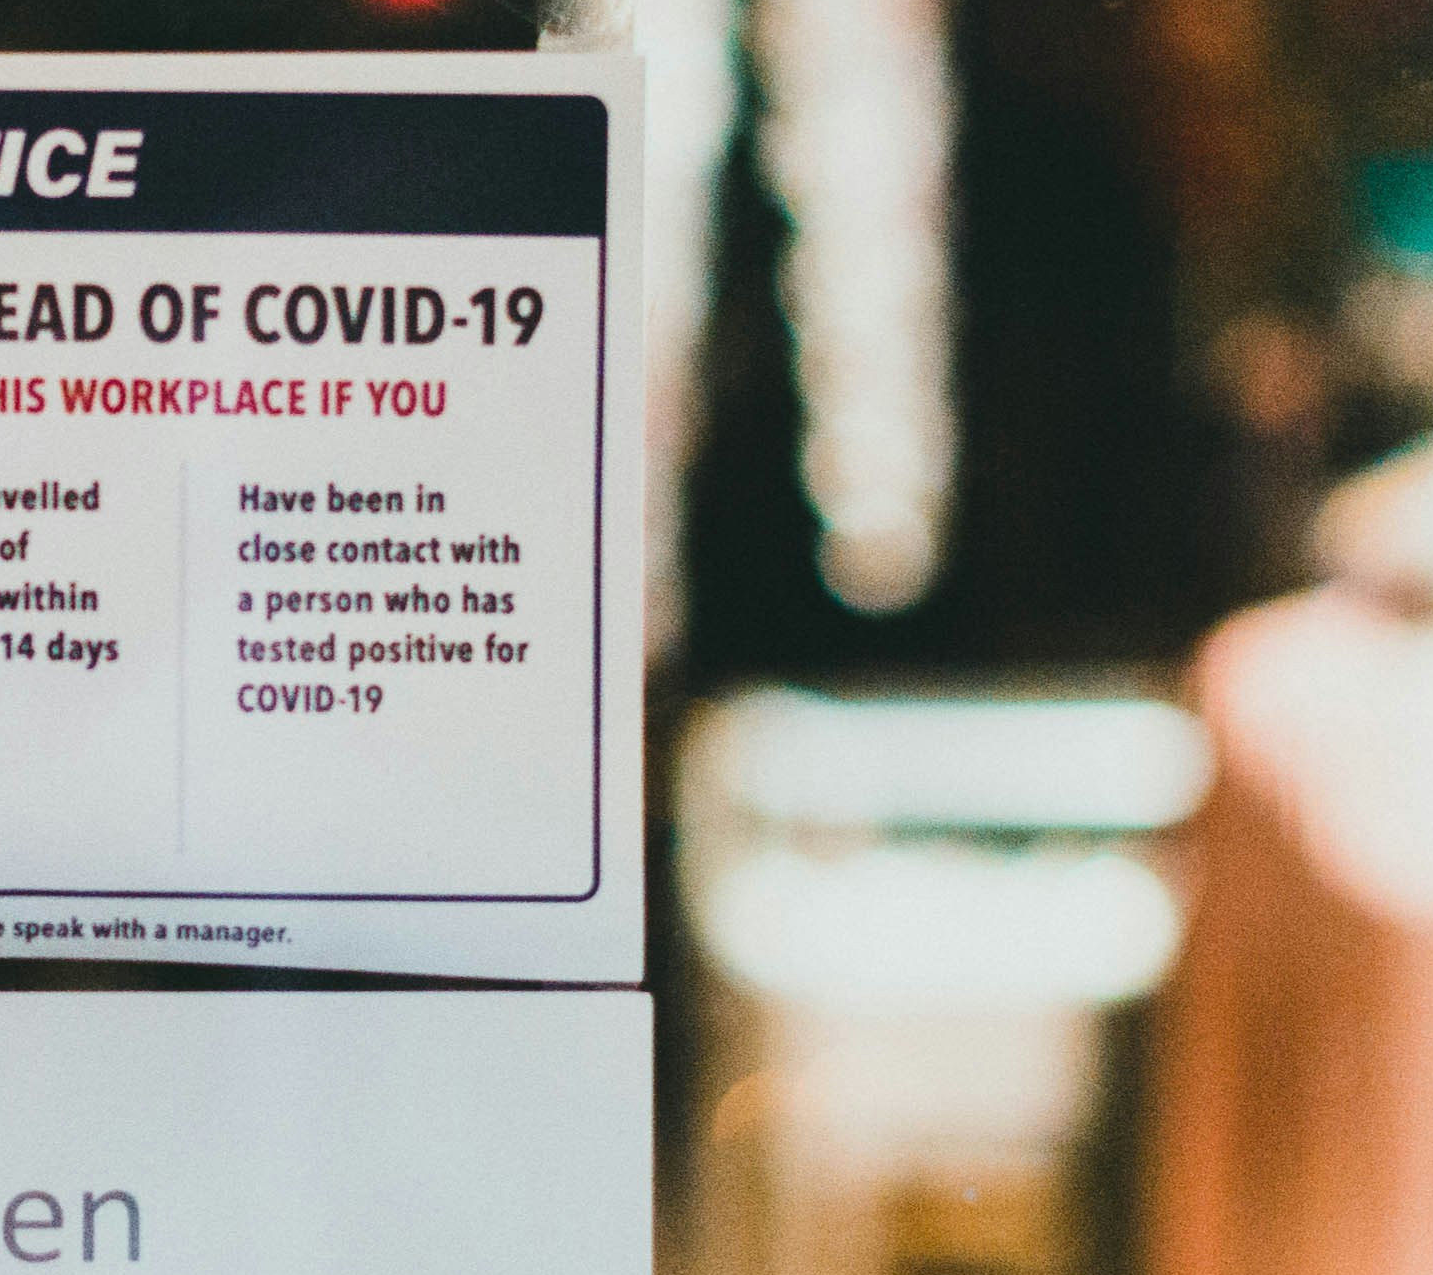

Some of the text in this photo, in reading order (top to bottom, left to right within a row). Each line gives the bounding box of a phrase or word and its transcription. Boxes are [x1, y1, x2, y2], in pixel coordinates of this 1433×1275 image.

[138, 282, 222, 345] OF
[243, 283, 545, 347] COVID-19
[59, 377, 306, 417] WORKPLACE
[320, 380, 353, 417] IF
[366, 379, 447, 418] YOU
[239, 482, 446, 515] Have been in
[237, 532, 521, 565] close contact with
[237, 583, 516, 622] a person who has
[0, 632, 36, 661] 14
[46, 630, 120, 671] days
[237, 631, 530, 672] tested positive for
[237, 683, 384, 714] COVID-19
[12, 916, 84, 944] speak
[91, 917, 147, 940] with
[153, 923, 169, 941] a
[175, 923, 293, 949] manager.
